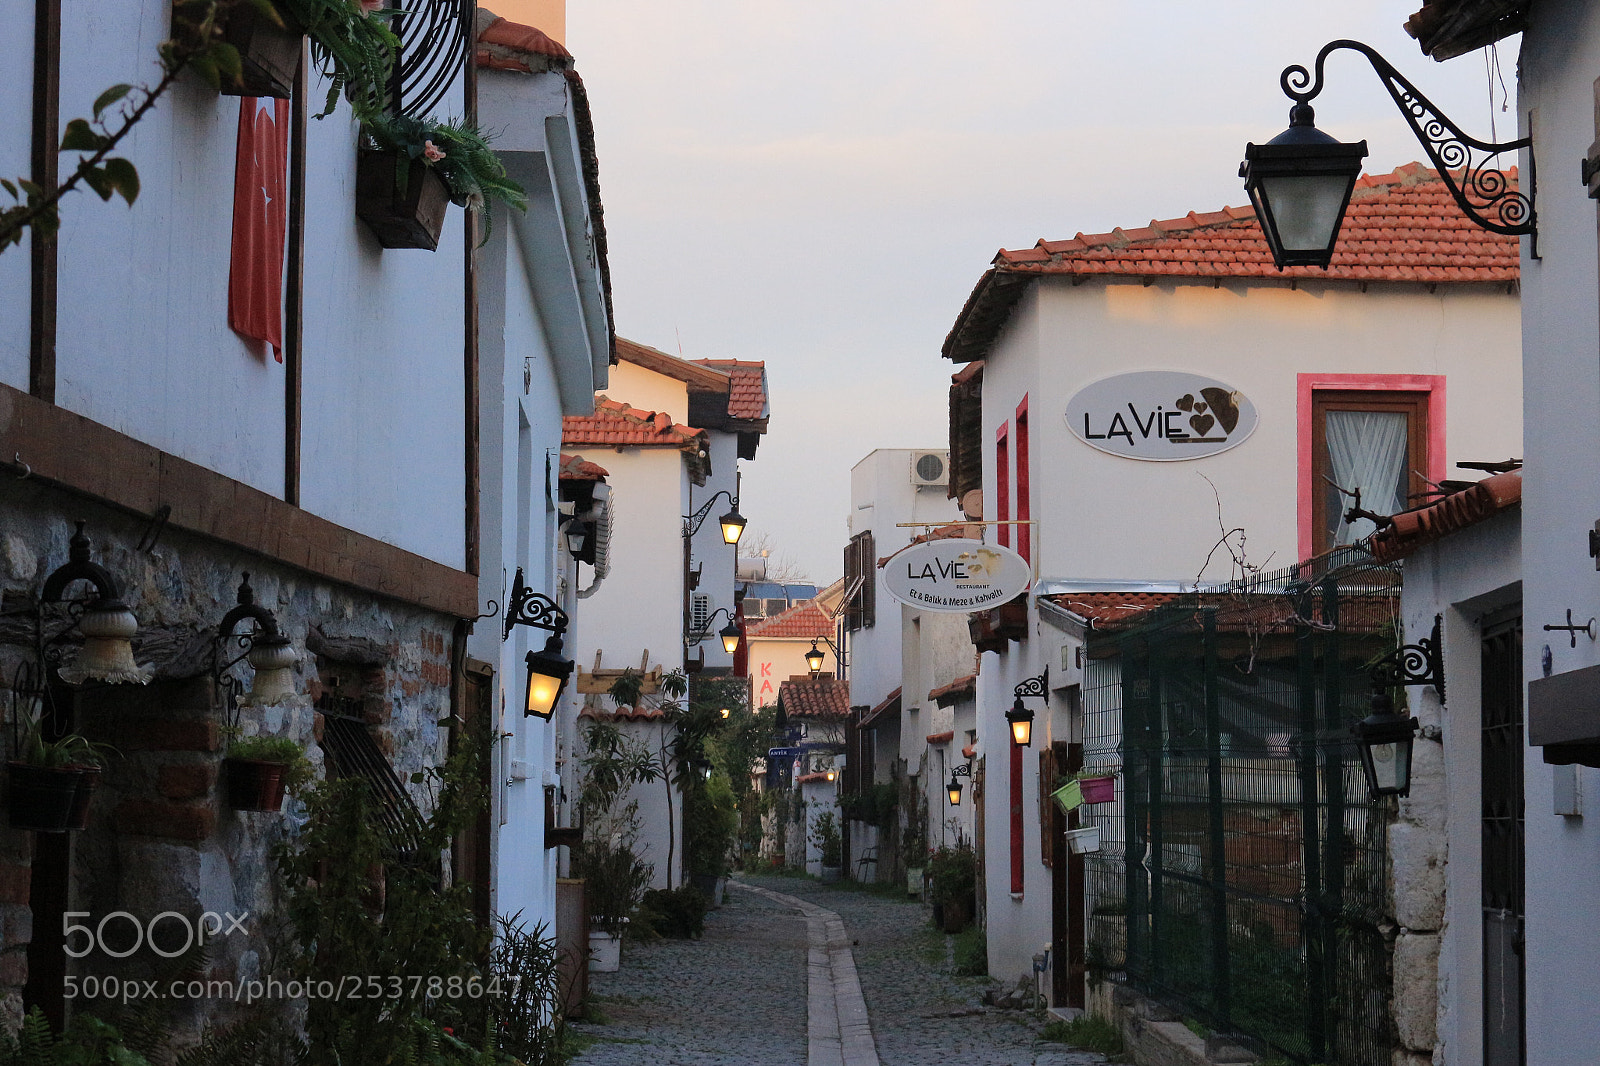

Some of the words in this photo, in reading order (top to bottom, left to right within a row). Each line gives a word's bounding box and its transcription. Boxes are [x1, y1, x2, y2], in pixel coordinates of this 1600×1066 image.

[910, 588, 918, 599] Et
[918, 592, 923, 601] &
[942, 598, 948, 606] &
[949, 597, 968, 606] Meze
[969, 597, 974, 605] &
